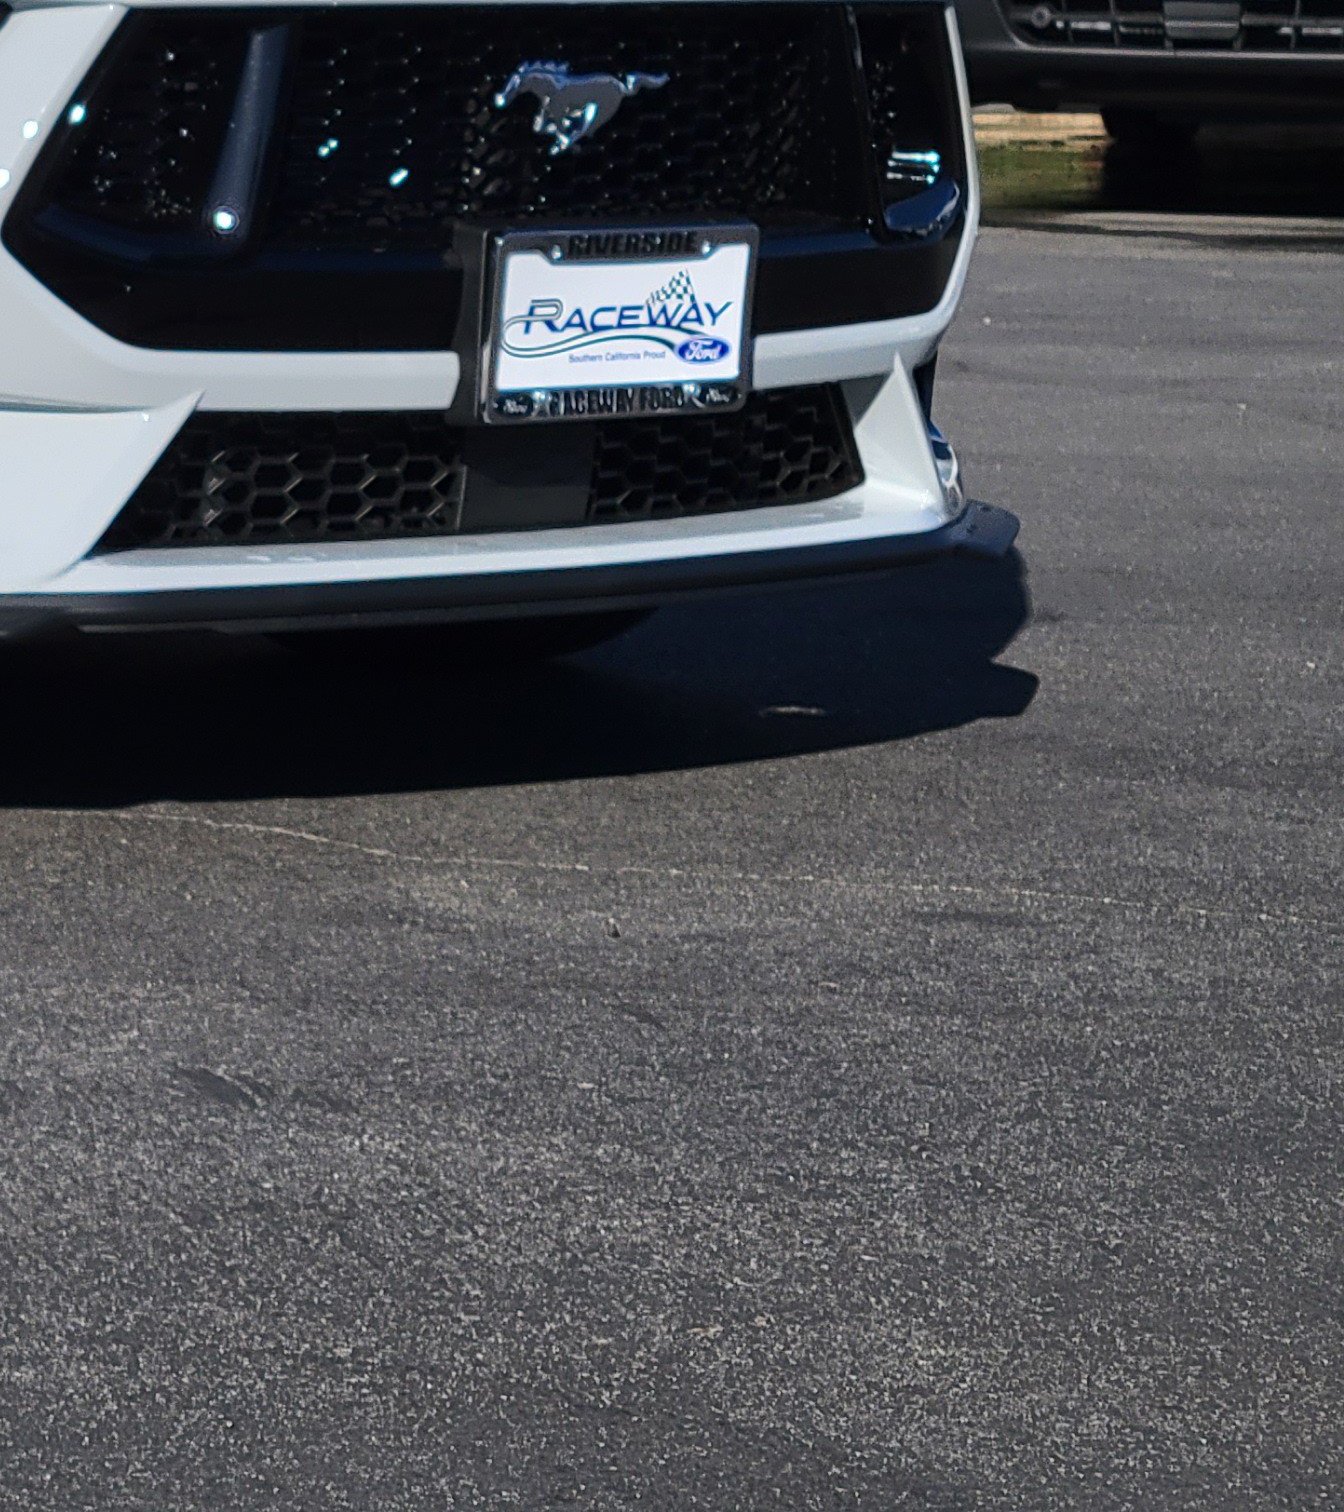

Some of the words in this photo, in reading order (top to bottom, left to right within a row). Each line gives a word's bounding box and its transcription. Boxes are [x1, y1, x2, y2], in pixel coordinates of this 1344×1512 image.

[568, 230, 699, 256] RIVERSIDE
[523, 298, 734, 335] RACEWAY
[568, 353, 603, 364] Southern
[605, 351, 642, 363] California
[643, 349, 666, 361] Proud
[683, 340, 723, 361] Ford
